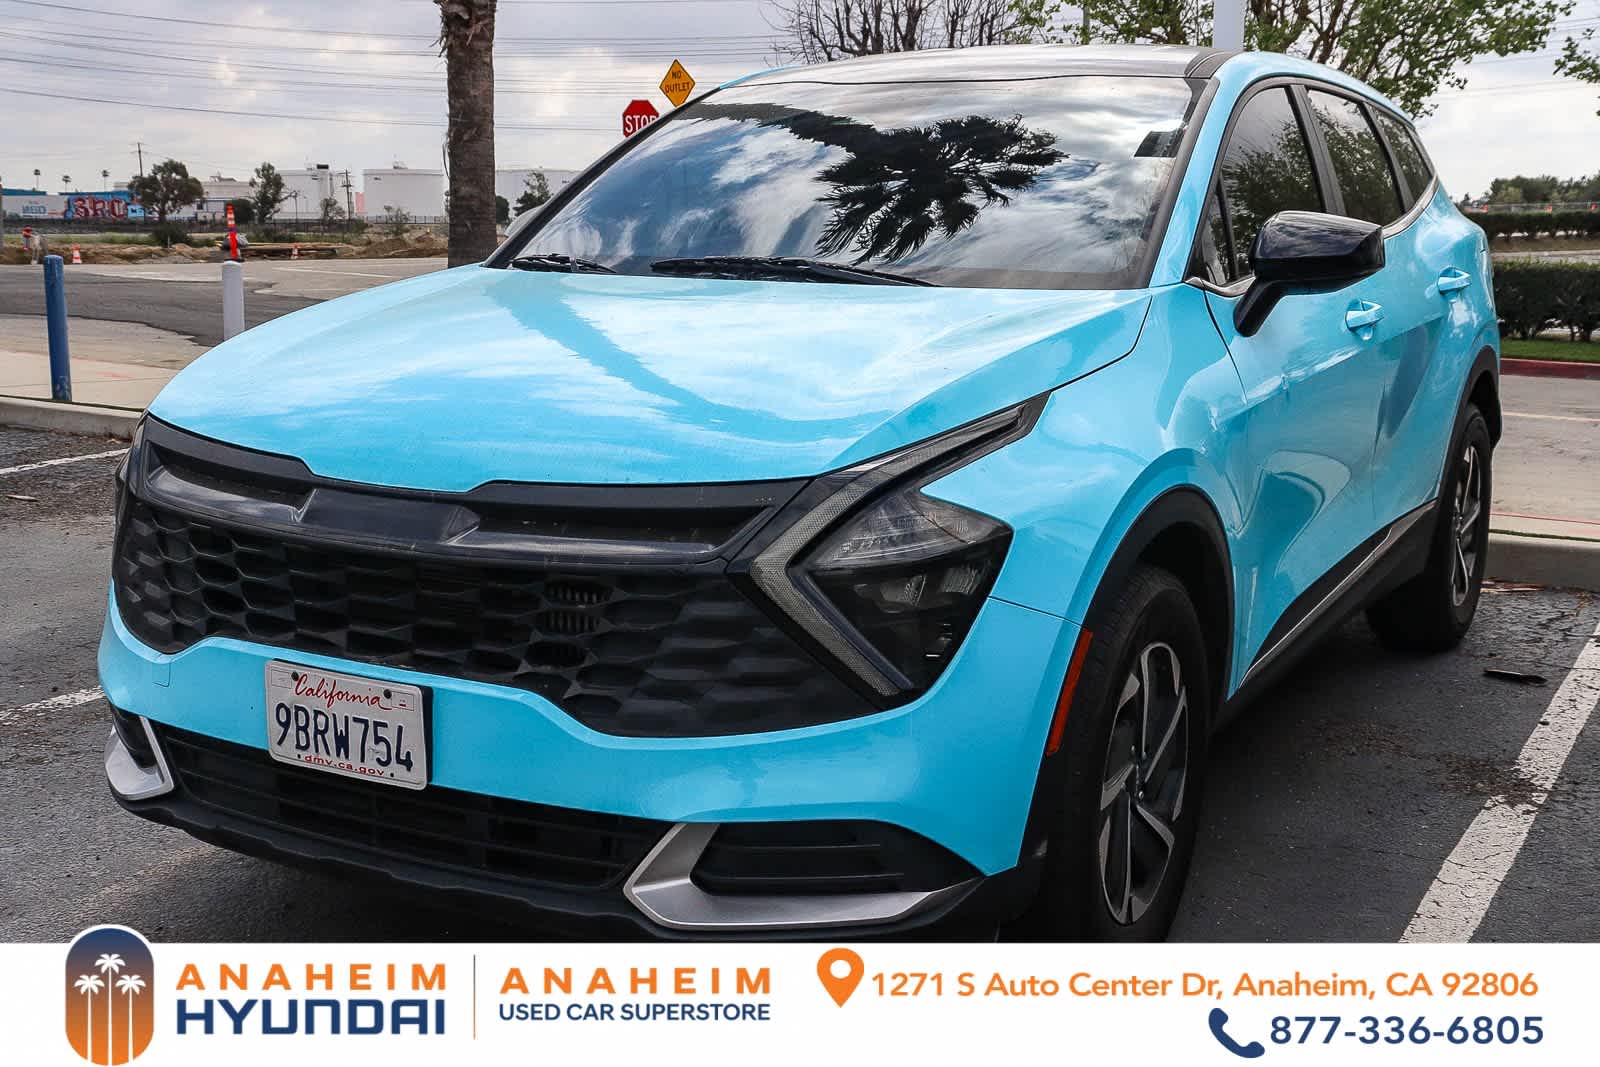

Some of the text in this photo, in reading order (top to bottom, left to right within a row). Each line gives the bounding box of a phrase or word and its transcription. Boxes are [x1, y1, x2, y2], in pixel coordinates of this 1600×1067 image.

[671, 70, 682, 80] NO
[664, 82, 690, 93] OUTLET
[294, 673, 392, 711] California
[275, 702, 414, 772] 9BRW754
[304, 754, 385, 777] dmv.ca.gov
